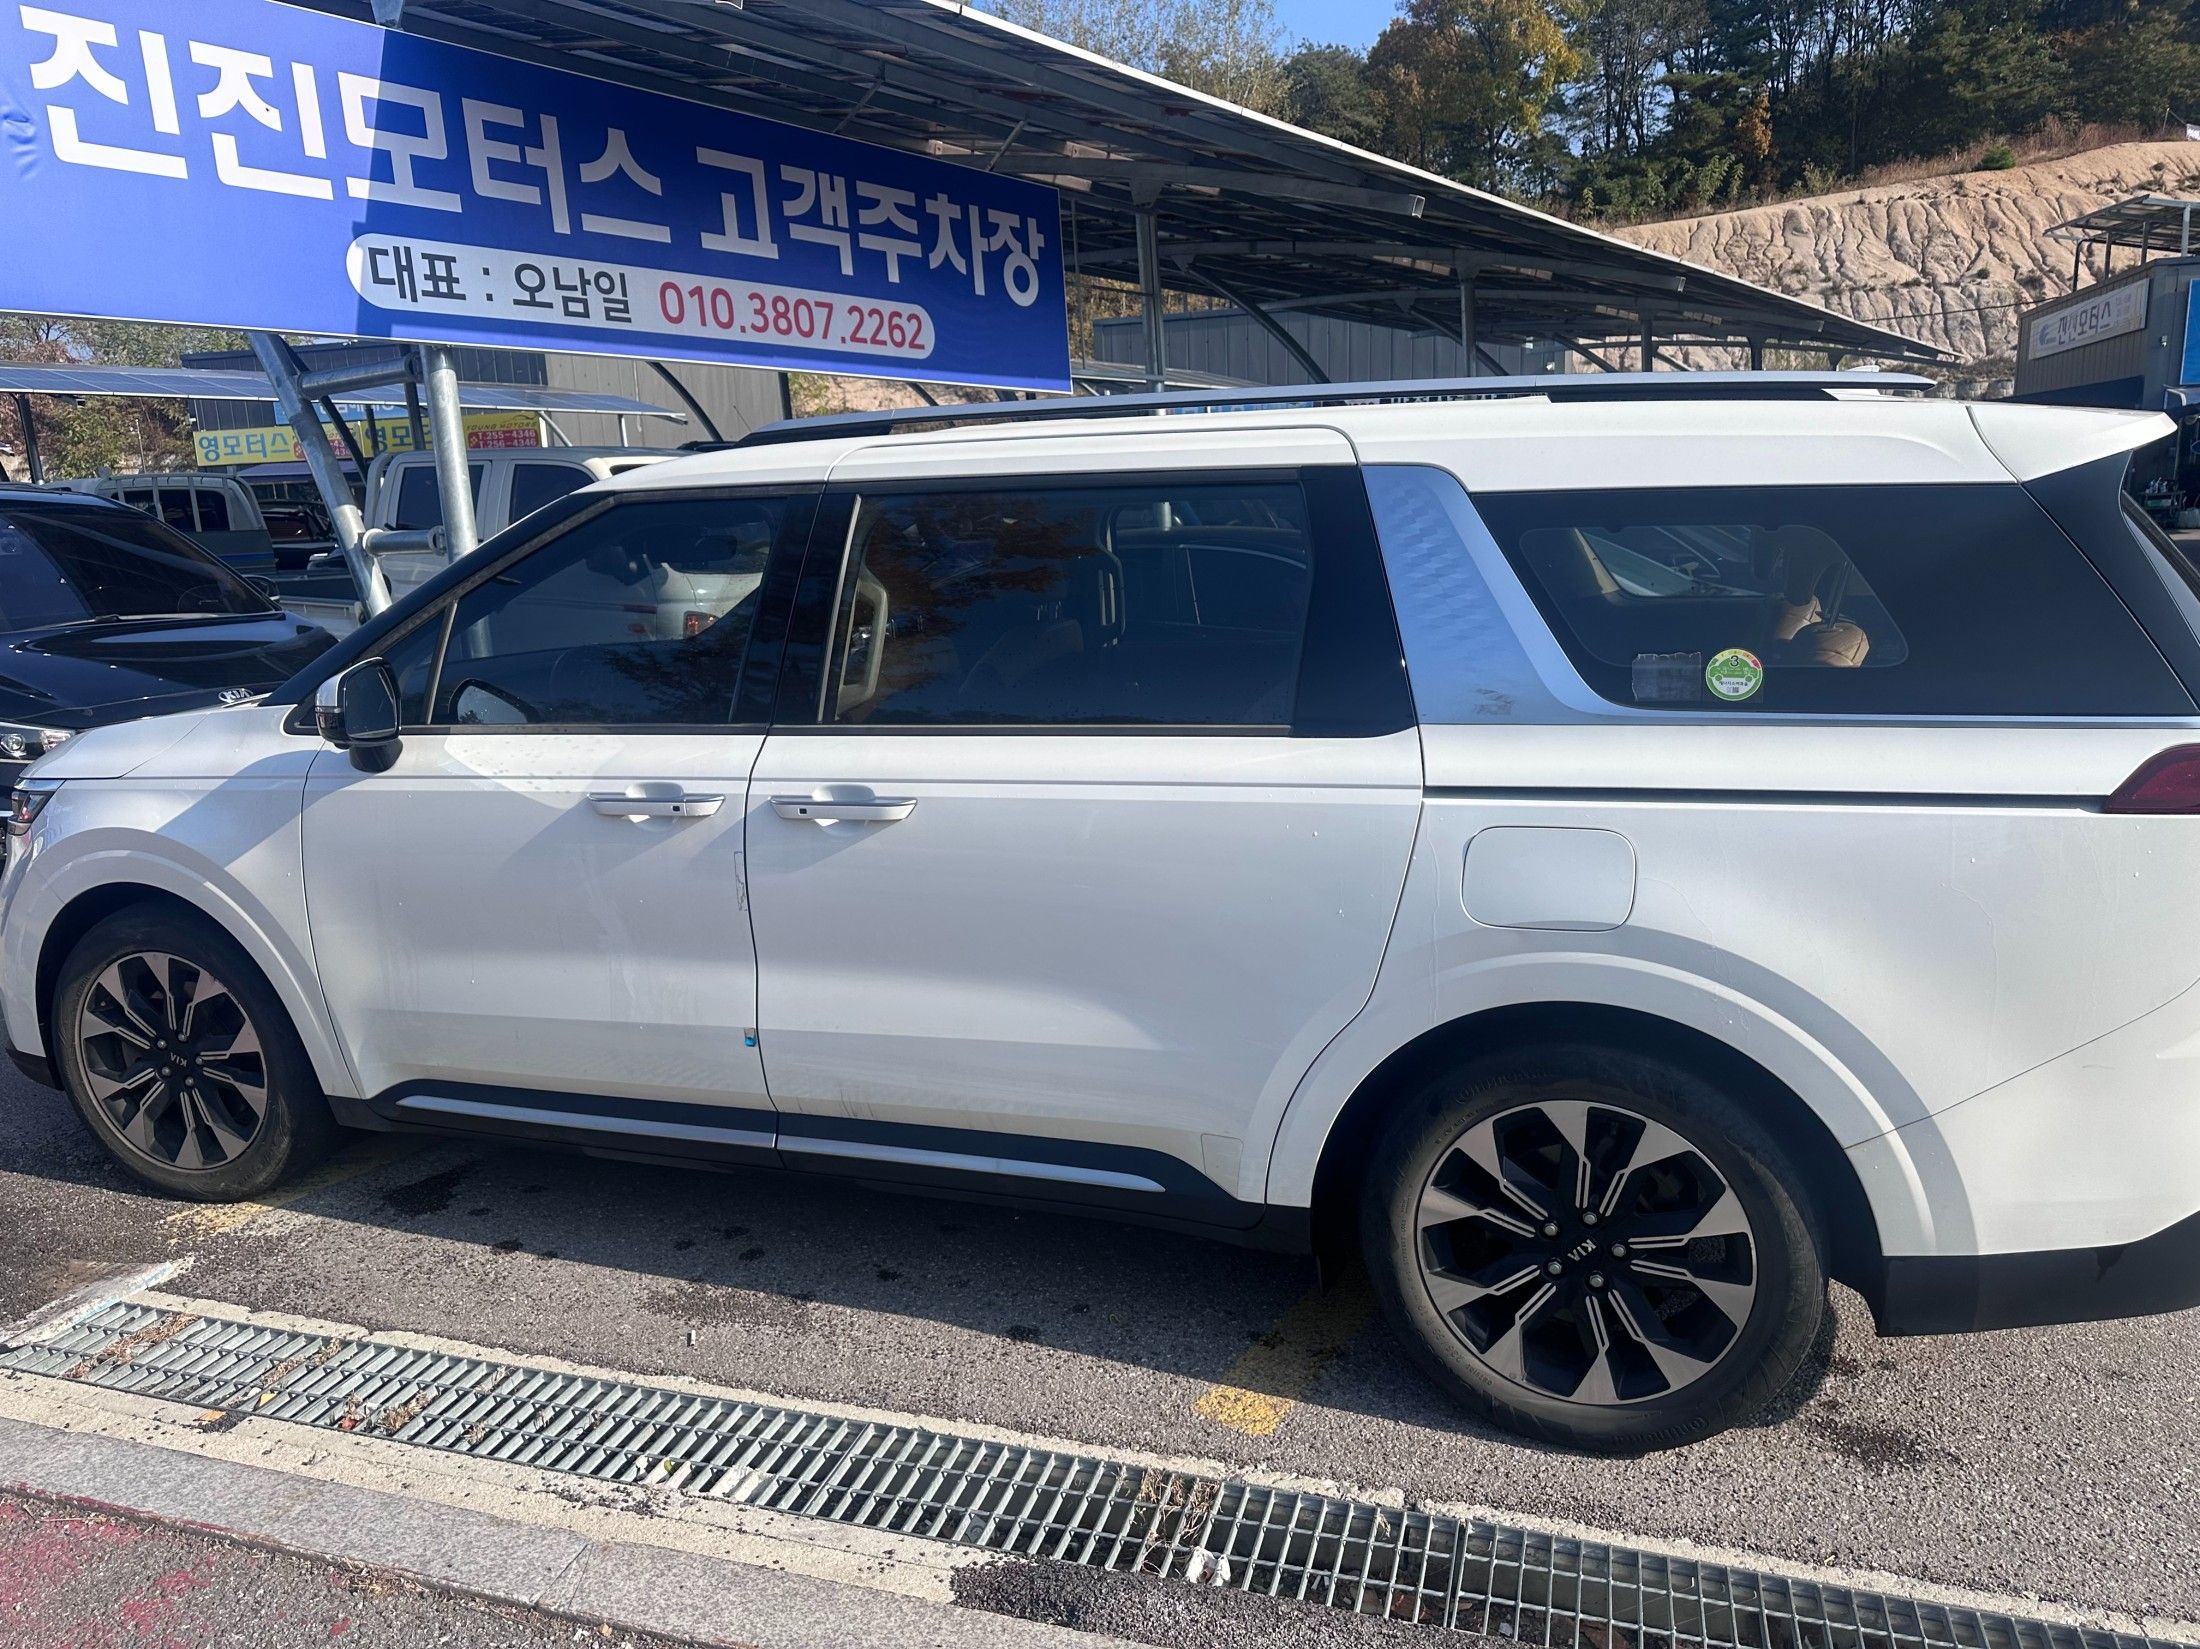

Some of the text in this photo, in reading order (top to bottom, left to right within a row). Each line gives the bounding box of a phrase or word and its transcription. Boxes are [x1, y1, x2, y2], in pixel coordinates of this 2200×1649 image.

[19, 5, 1045, 307] 진진모터스 고객주차장
[368, 245, 467, 303] 대표
[512, 262, 632, 323] 오남일
[659, 281, 926, 350] 010.3807.2262
[198, 431, 290, 463] 영모터스
[1729, 654, 1740, 667] 3
[221, 687, 252, 702] KIA
[170, 1052, 188, 1067] KIA
[1567, 1238, 1597, 1262] KIA
